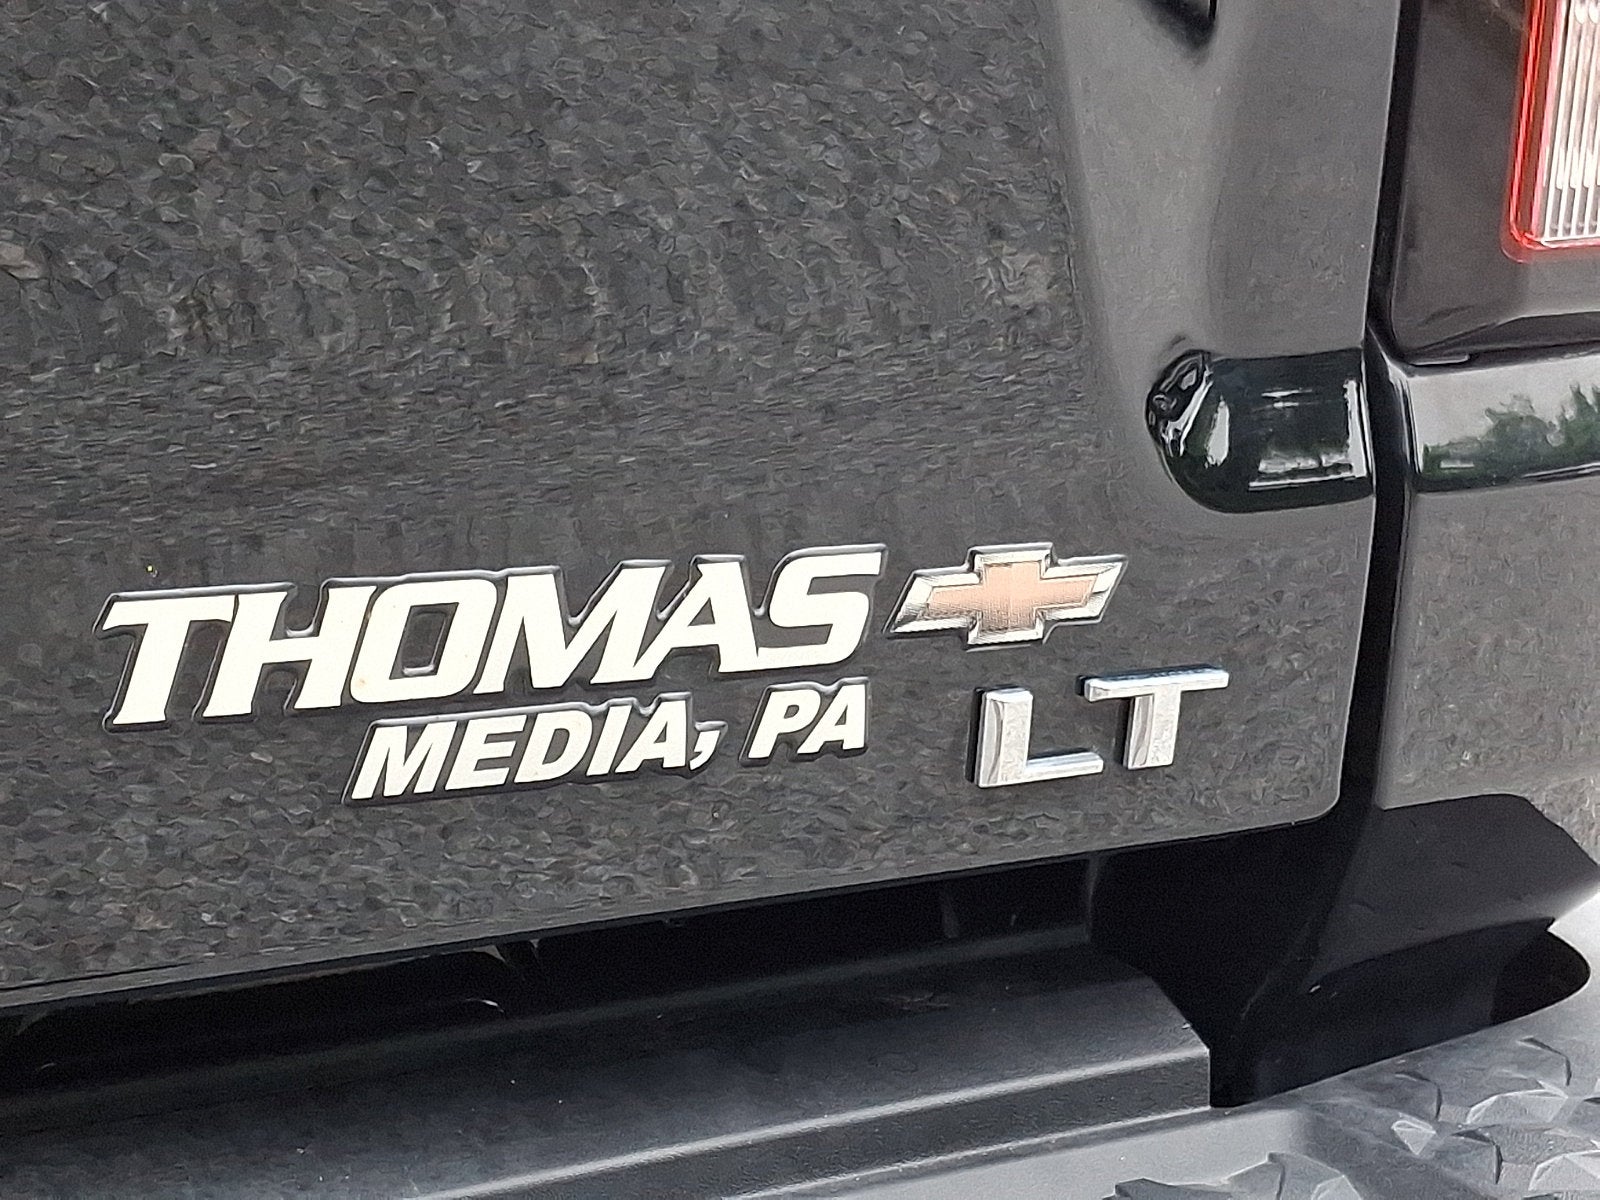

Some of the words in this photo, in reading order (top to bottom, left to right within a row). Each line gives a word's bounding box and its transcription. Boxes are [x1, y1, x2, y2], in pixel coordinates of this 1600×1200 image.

[104, 547, 884, 726] THOMAS
[351, 692, 722, 800] MEDIA,
[747, 680, 867, 761] PA
[974, 667, 1229, 788] LT
